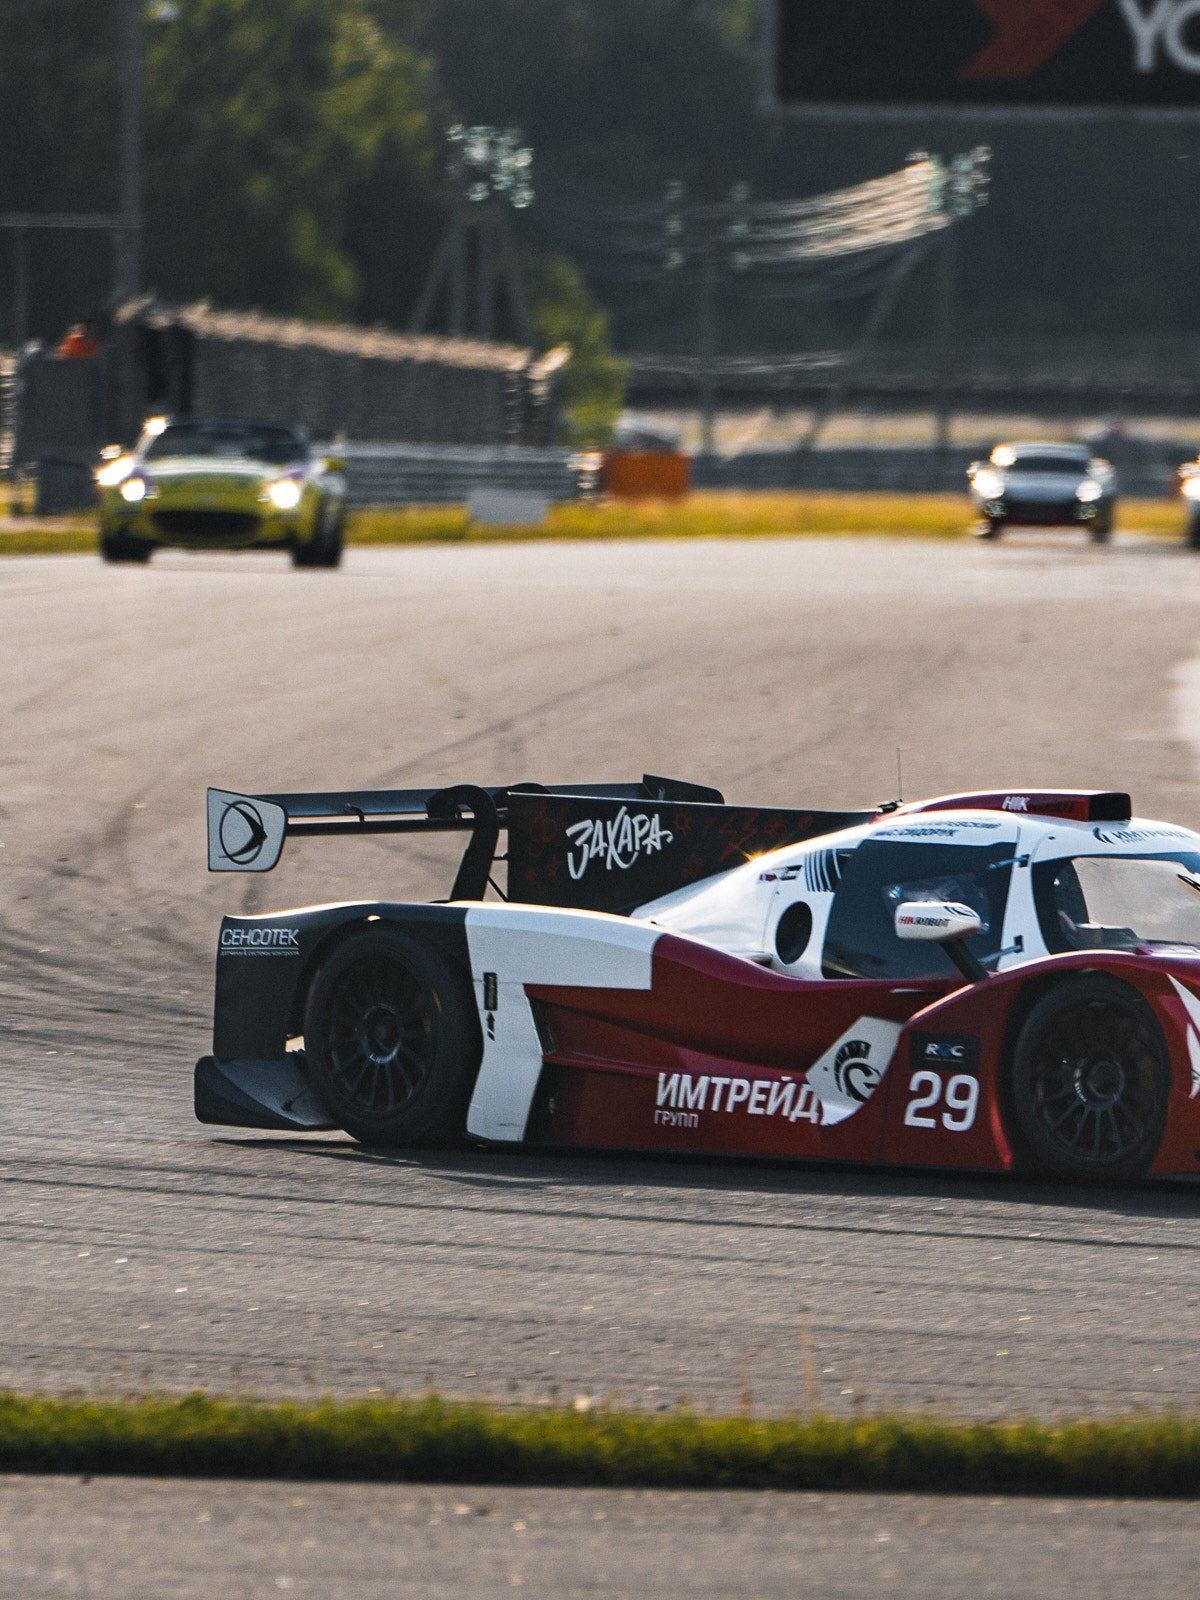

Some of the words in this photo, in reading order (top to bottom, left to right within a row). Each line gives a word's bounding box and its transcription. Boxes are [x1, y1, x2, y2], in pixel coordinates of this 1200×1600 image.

[221, 928, 300, 946] СЕНСОТЕК
[656, 1072, 820, 1125] ИМТРЕЙД
[904, 1070, 980, 1132] 29
[654, 1110, 699, 1129] ГРУПП
